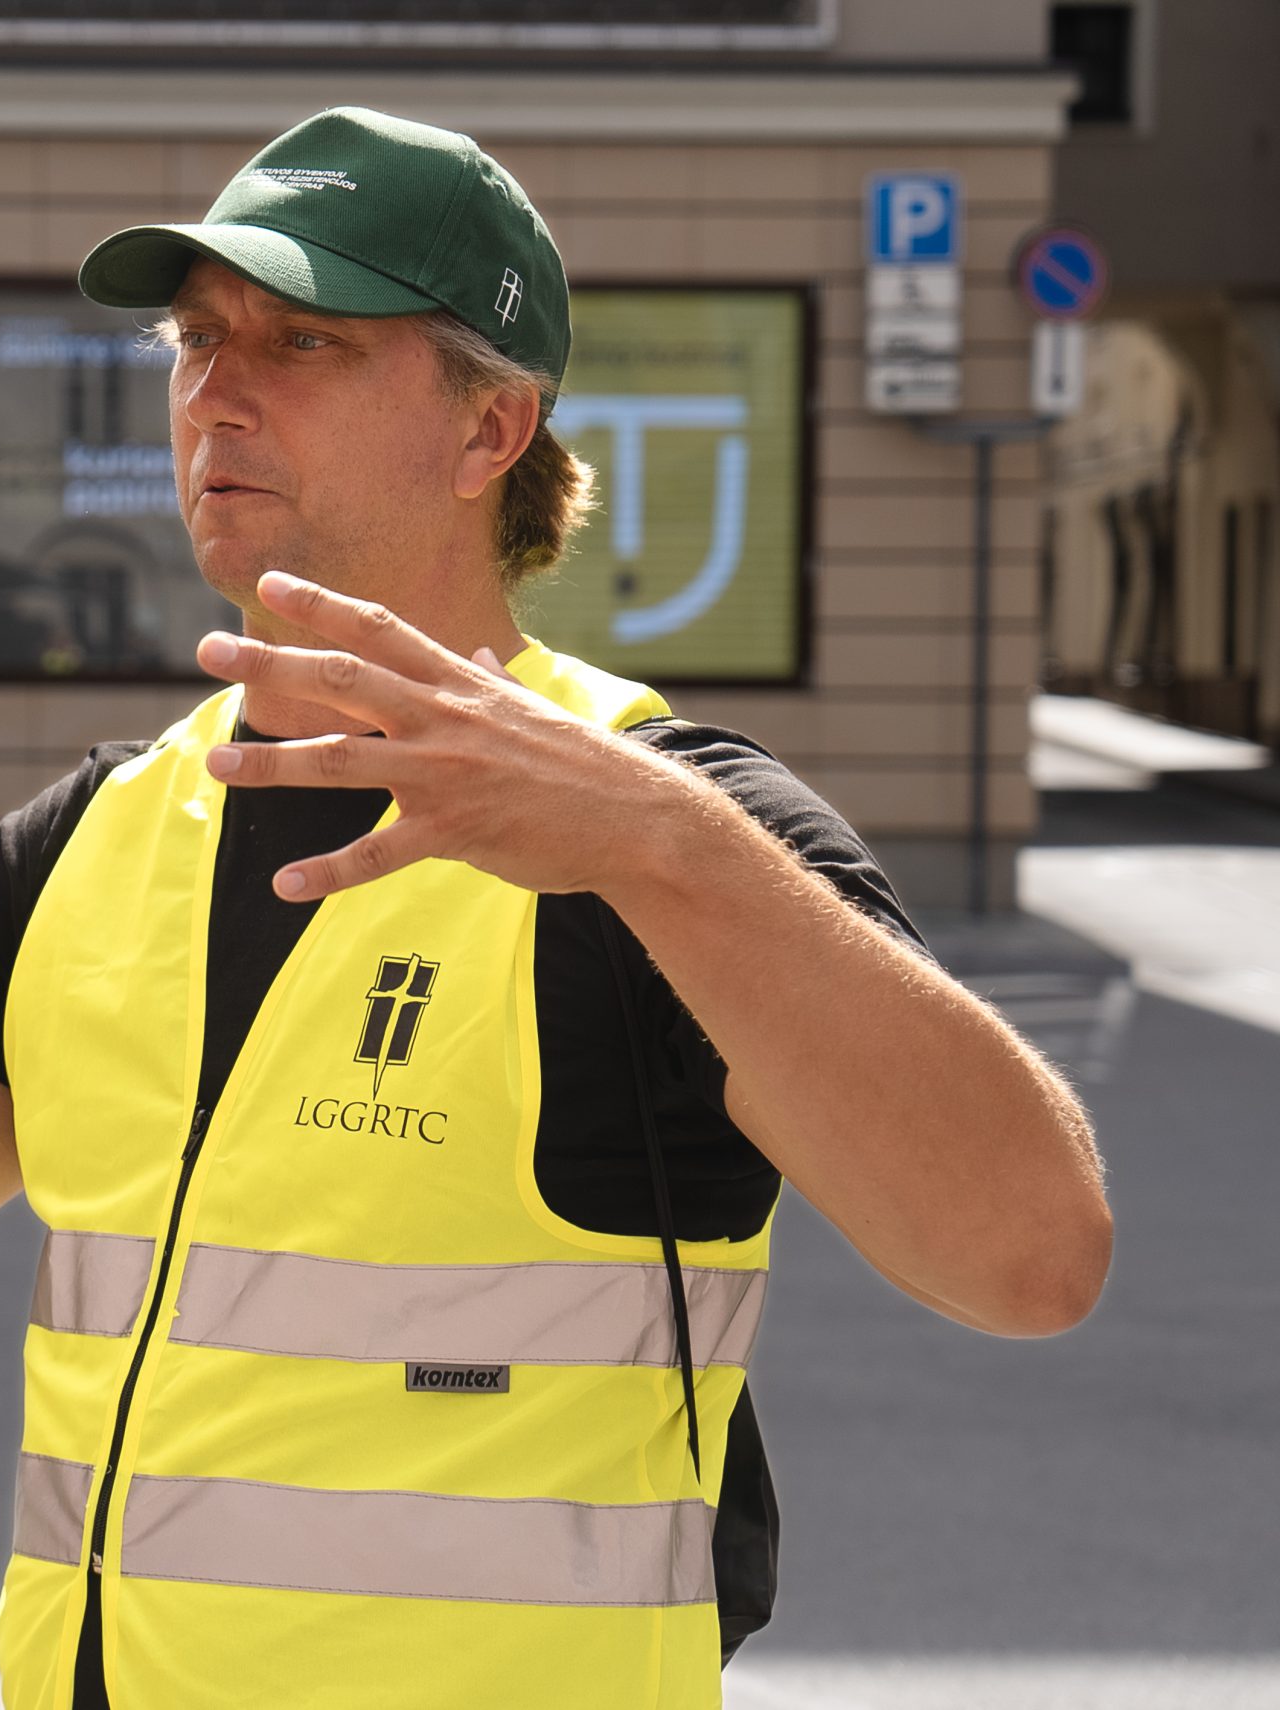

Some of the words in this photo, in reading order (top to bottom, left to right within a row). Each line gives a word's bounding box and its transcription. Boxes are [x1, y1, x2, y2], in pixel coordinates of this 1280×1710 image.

[889, 178, 946, 260] P
[293, 1096, 448, 1145] LGGRTC
[412, 1366, 503, 1388] korntex
